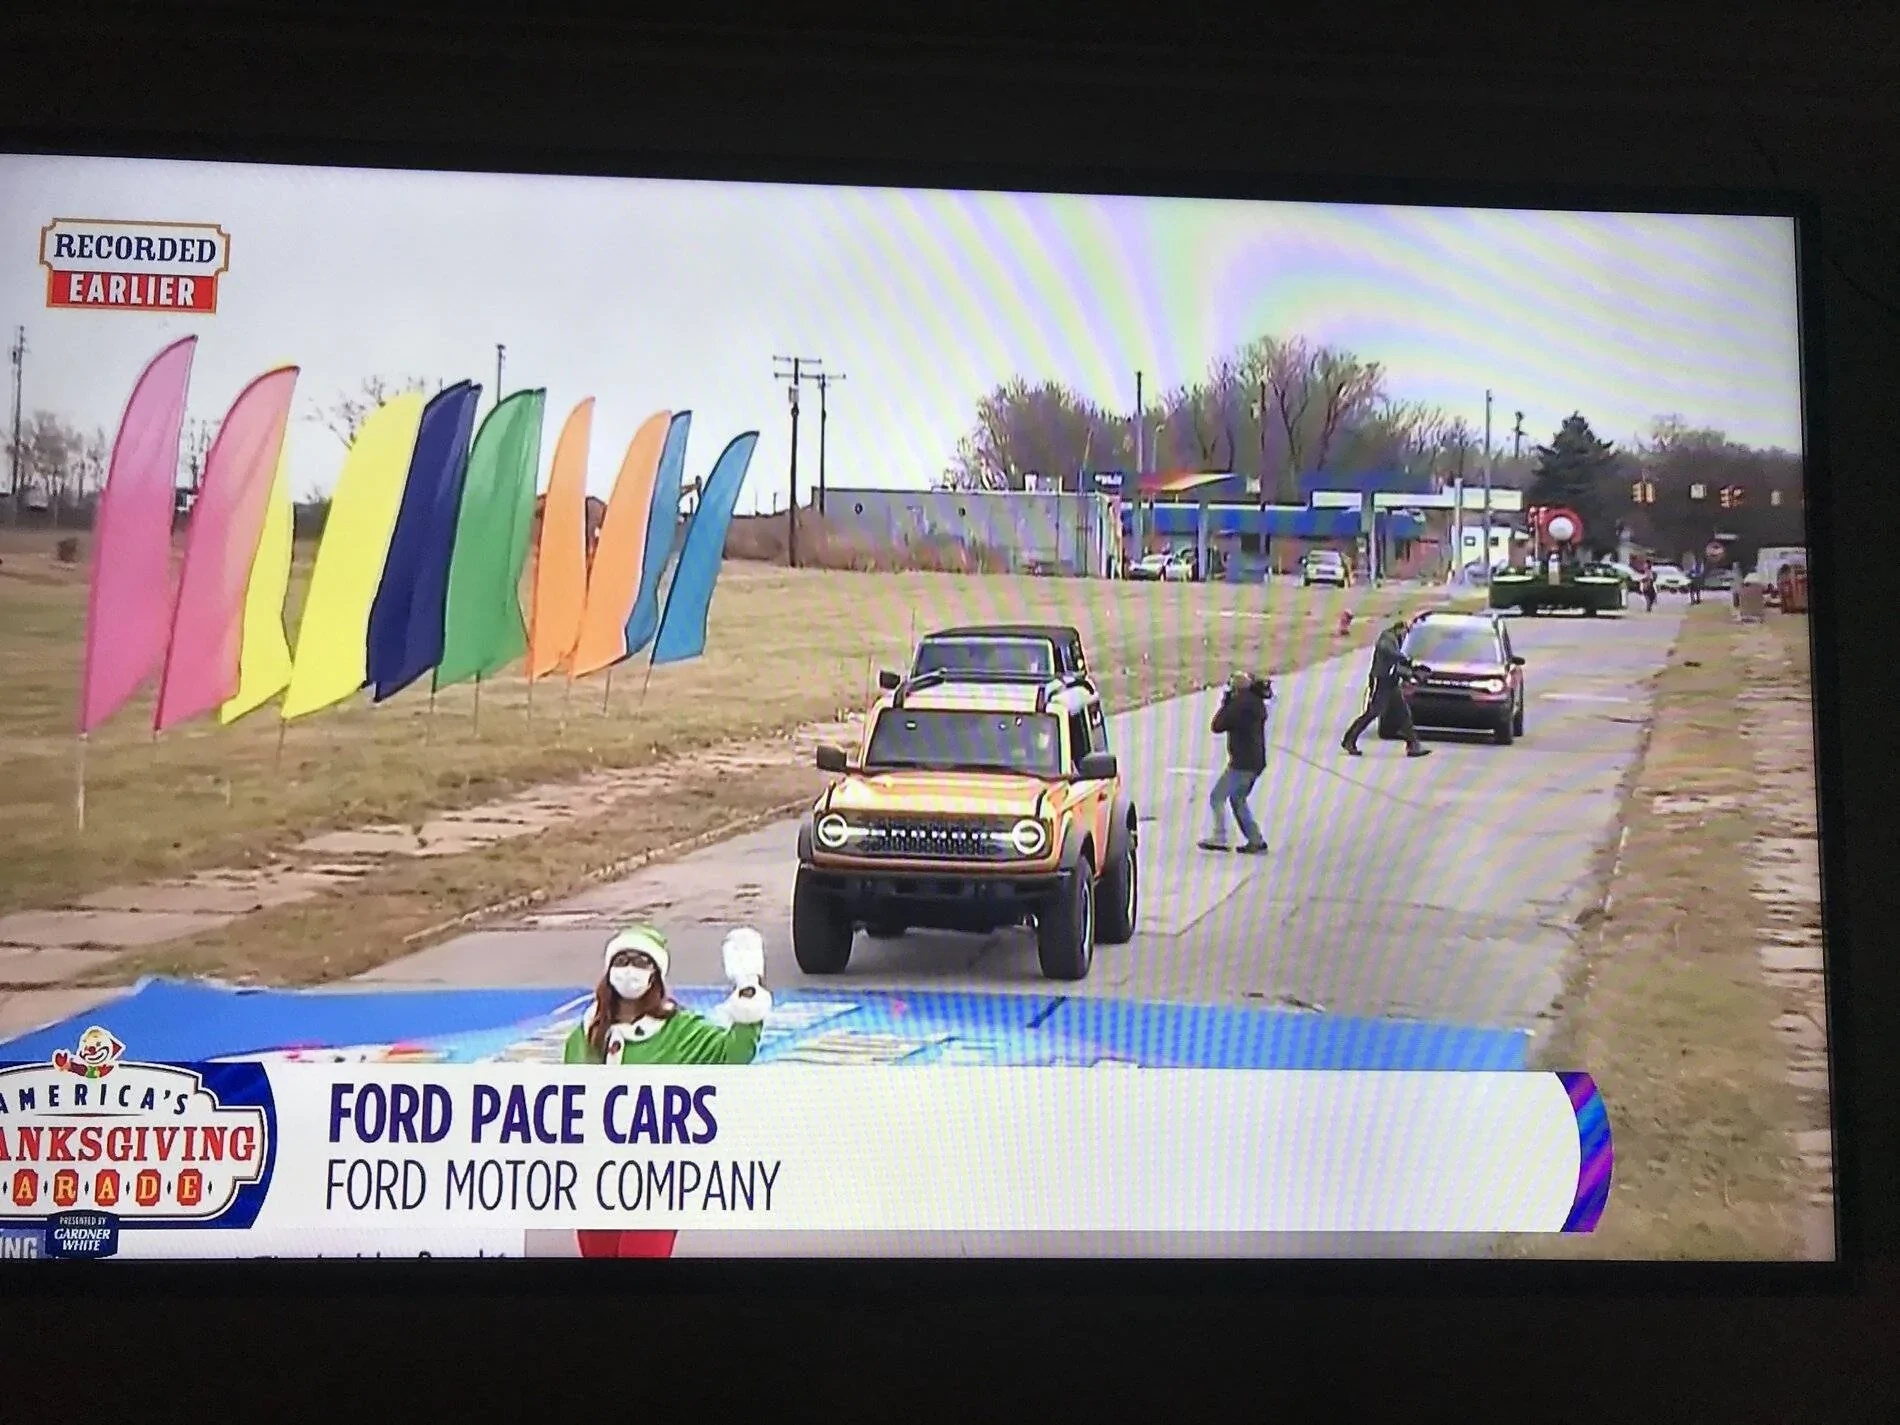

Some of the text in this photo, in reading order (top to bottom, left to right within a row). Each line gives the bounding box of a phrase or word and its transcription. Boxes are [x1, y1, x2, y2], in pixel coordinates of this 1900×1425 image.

[53, 233, 216, 264] RECORDED
[69, 273, 195, 307] EARLIER
[329, 1083, 718, 1145] FORD PACE CARS
[326, 1159, 781, 1212] FORD MOTOR COMPANY
[54, 1228, 110, 1240] GARDNER
[59, 1216, 107, 1225] PRESENTED BY
[62, 1239, 100, 1251] WHITE
